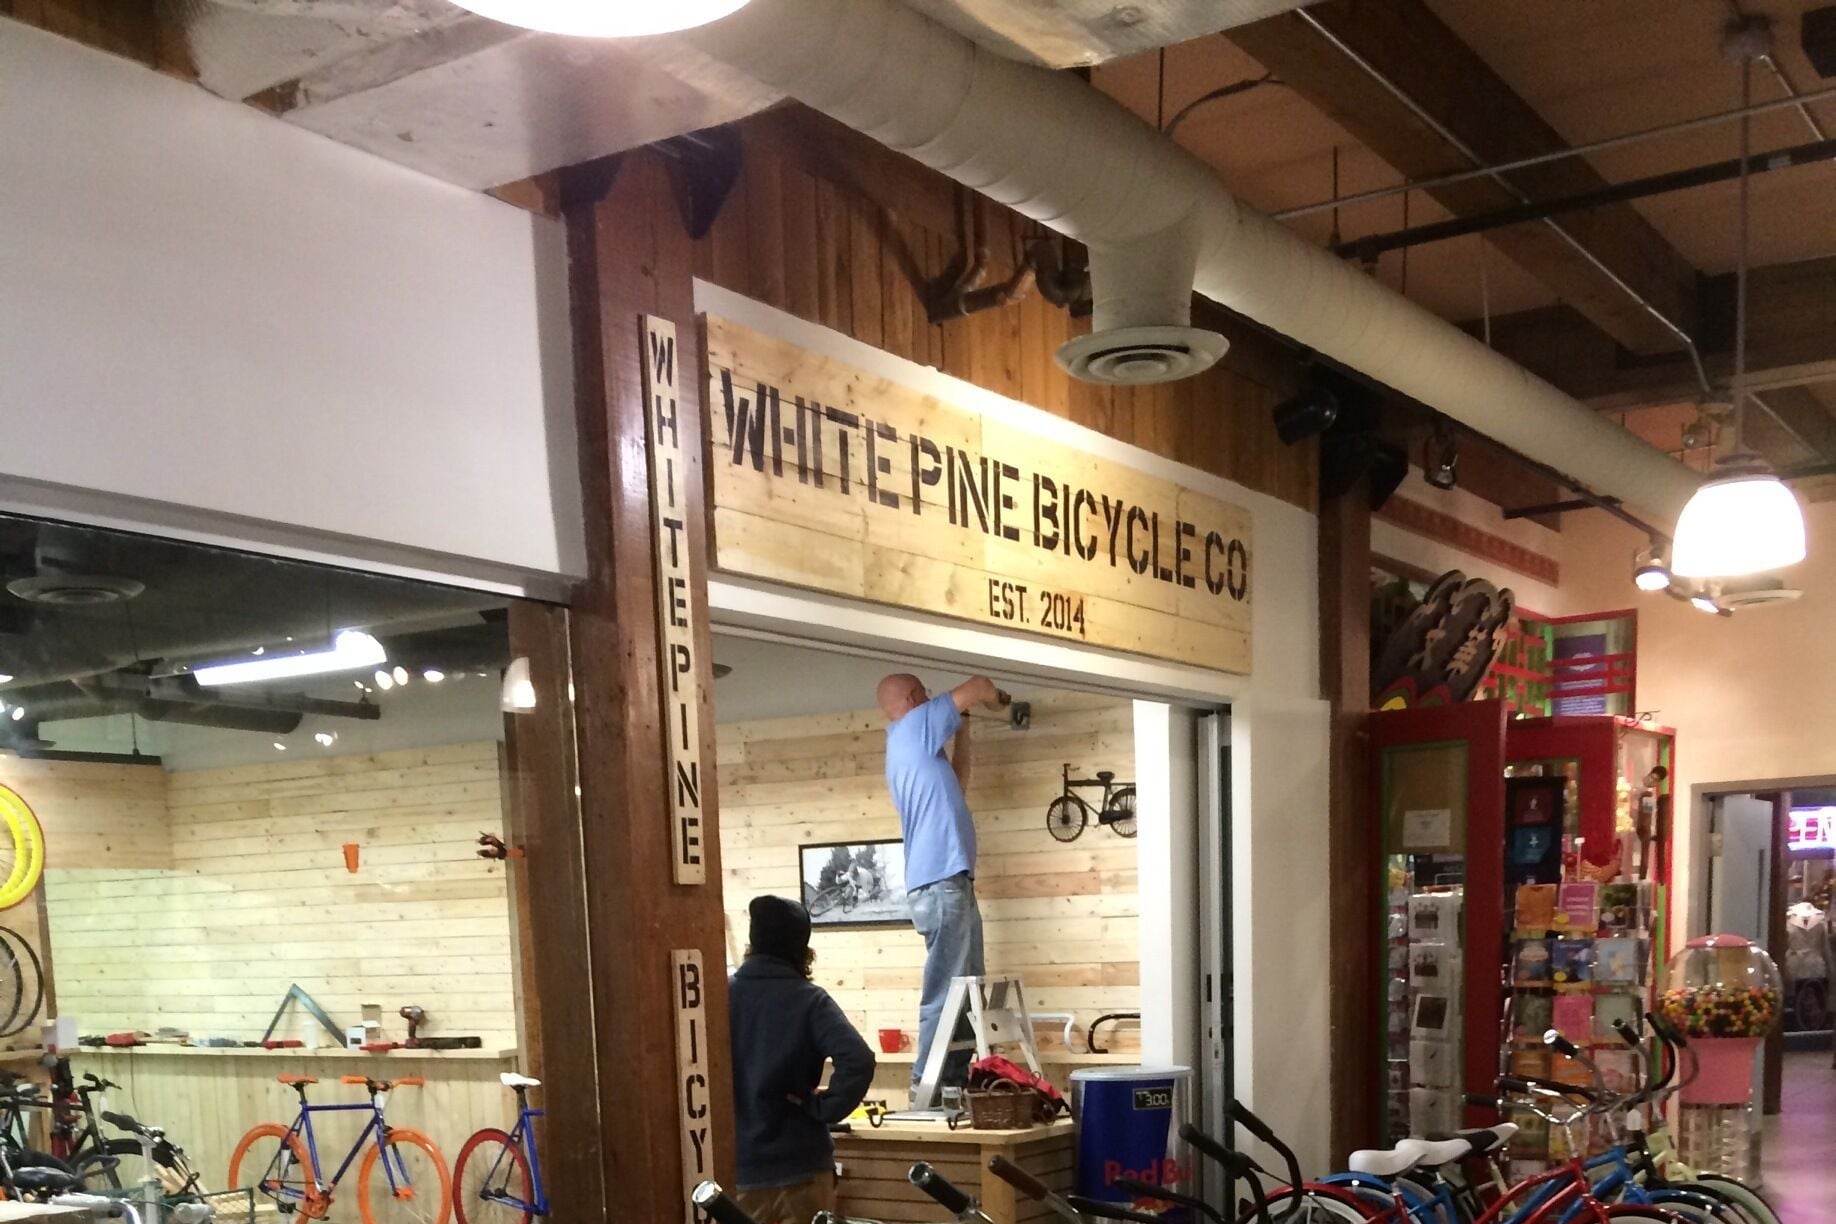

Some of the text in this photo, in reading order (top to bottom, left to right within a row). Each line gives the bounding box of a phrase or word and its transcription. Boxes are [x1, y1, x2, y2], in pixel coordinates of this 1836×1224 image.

[720, 368, 900, 510] WHITE
[909, 432, 1020, 543] PINE
[1033, 472, 1196, 590] BICYCLE
[649, 330, 701, 865] WHITE PINE
[988, 578, 1085, 634] EST. 2014
